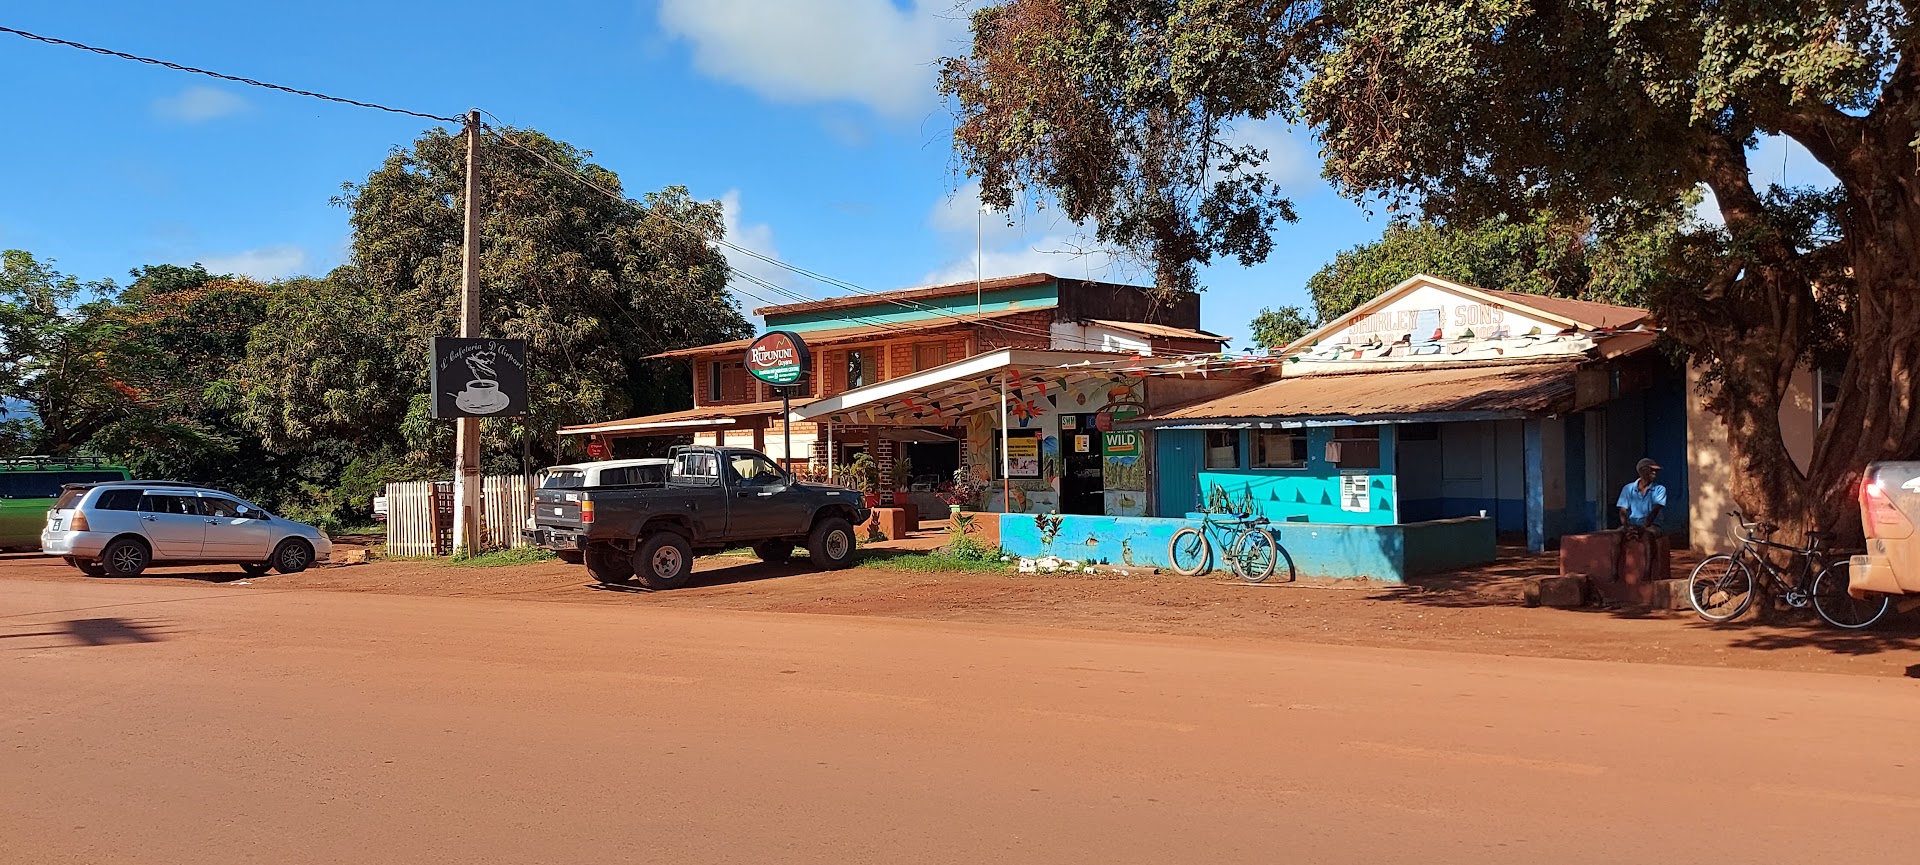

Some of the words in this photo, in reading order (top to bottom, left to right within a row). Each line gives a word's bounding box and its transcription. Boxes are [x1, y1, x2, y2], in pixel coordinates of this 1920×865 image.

[1349, 310, 1418, 334] SHIRLEY
[1455, 303, 1505, 327] SONS
[449, 343, 482, 363] Cafeteria
[488, 341, 523, 370] D'Airport
[751, 348, 793, 366] RUPUNUNI
[1106, 434, 1136, 446] WILD
